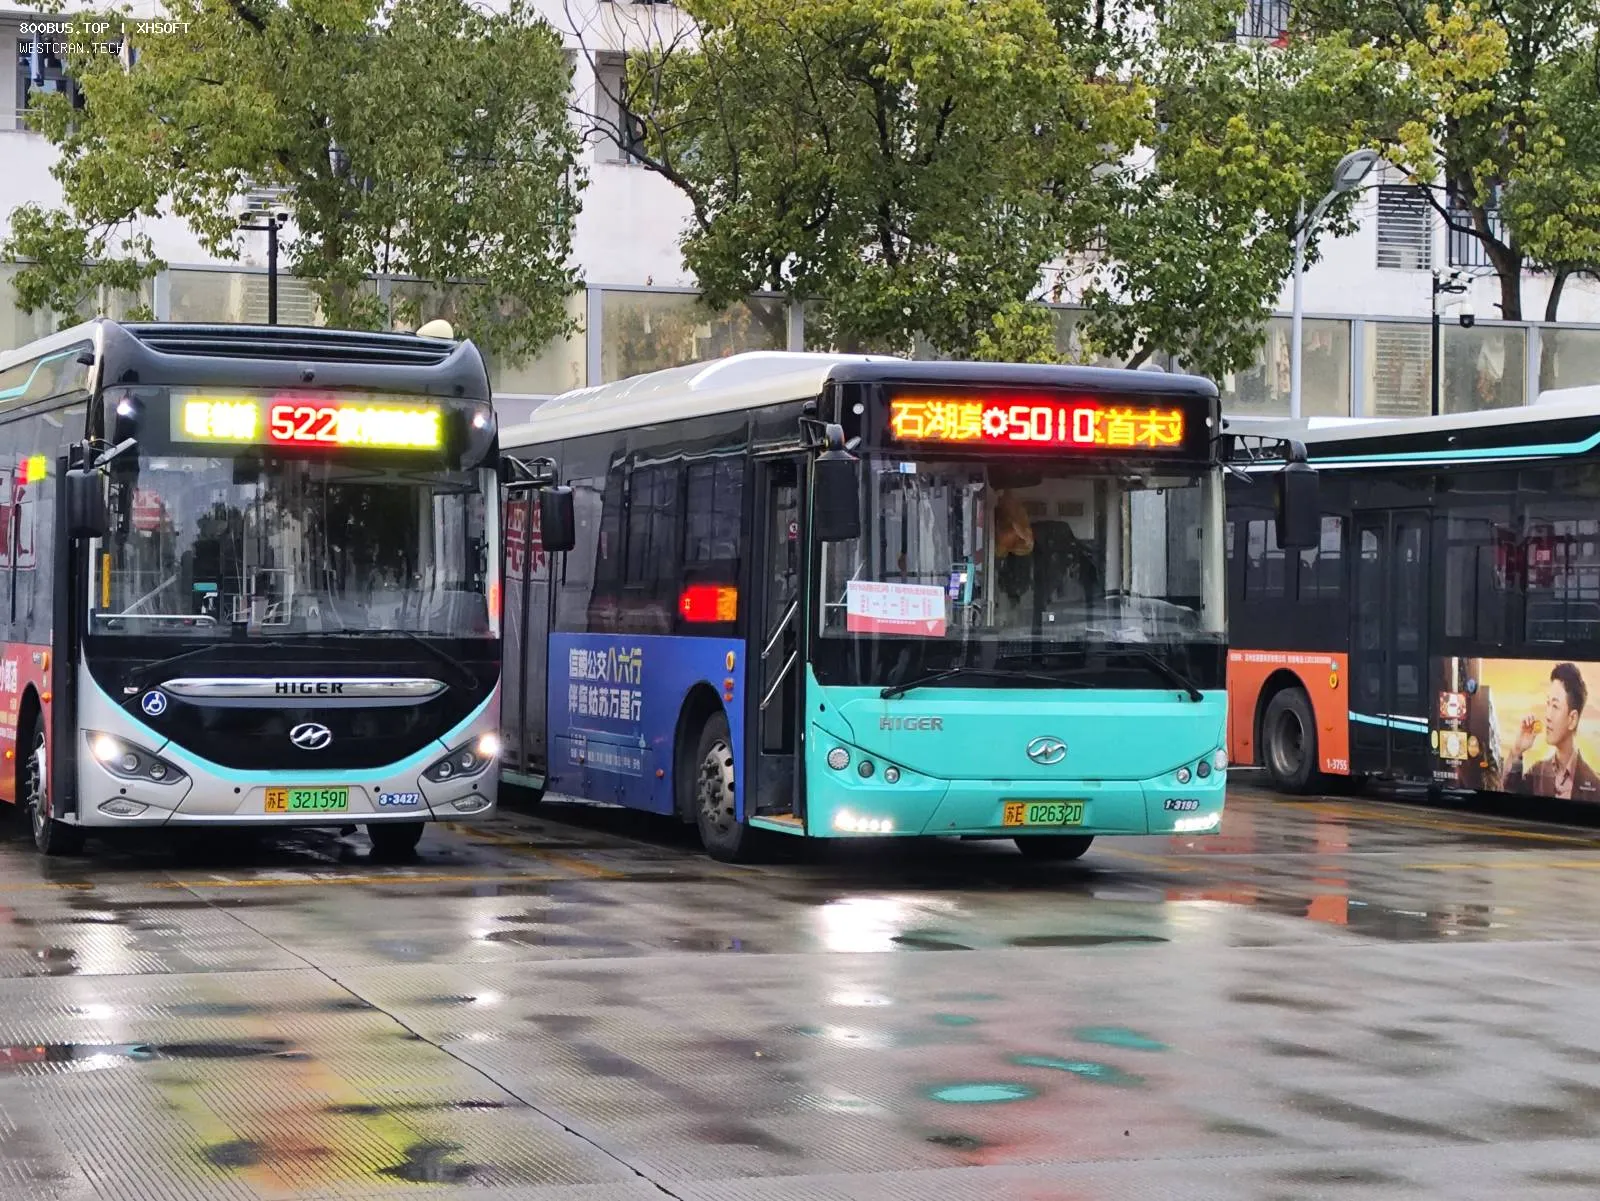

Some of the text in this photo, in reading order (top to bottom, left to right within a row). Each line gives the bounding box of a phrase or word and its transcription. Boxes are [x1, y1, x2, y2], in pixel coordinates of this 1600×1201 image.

[271, 405, 337, 441] 522
[275, 682, 344, 694] HIGER
[879, 716, 944, 731] HIGER
[267, 791, 347, 809] 苏E 32159D
[1006, 804, 1082, 823] 苏E 02632D
